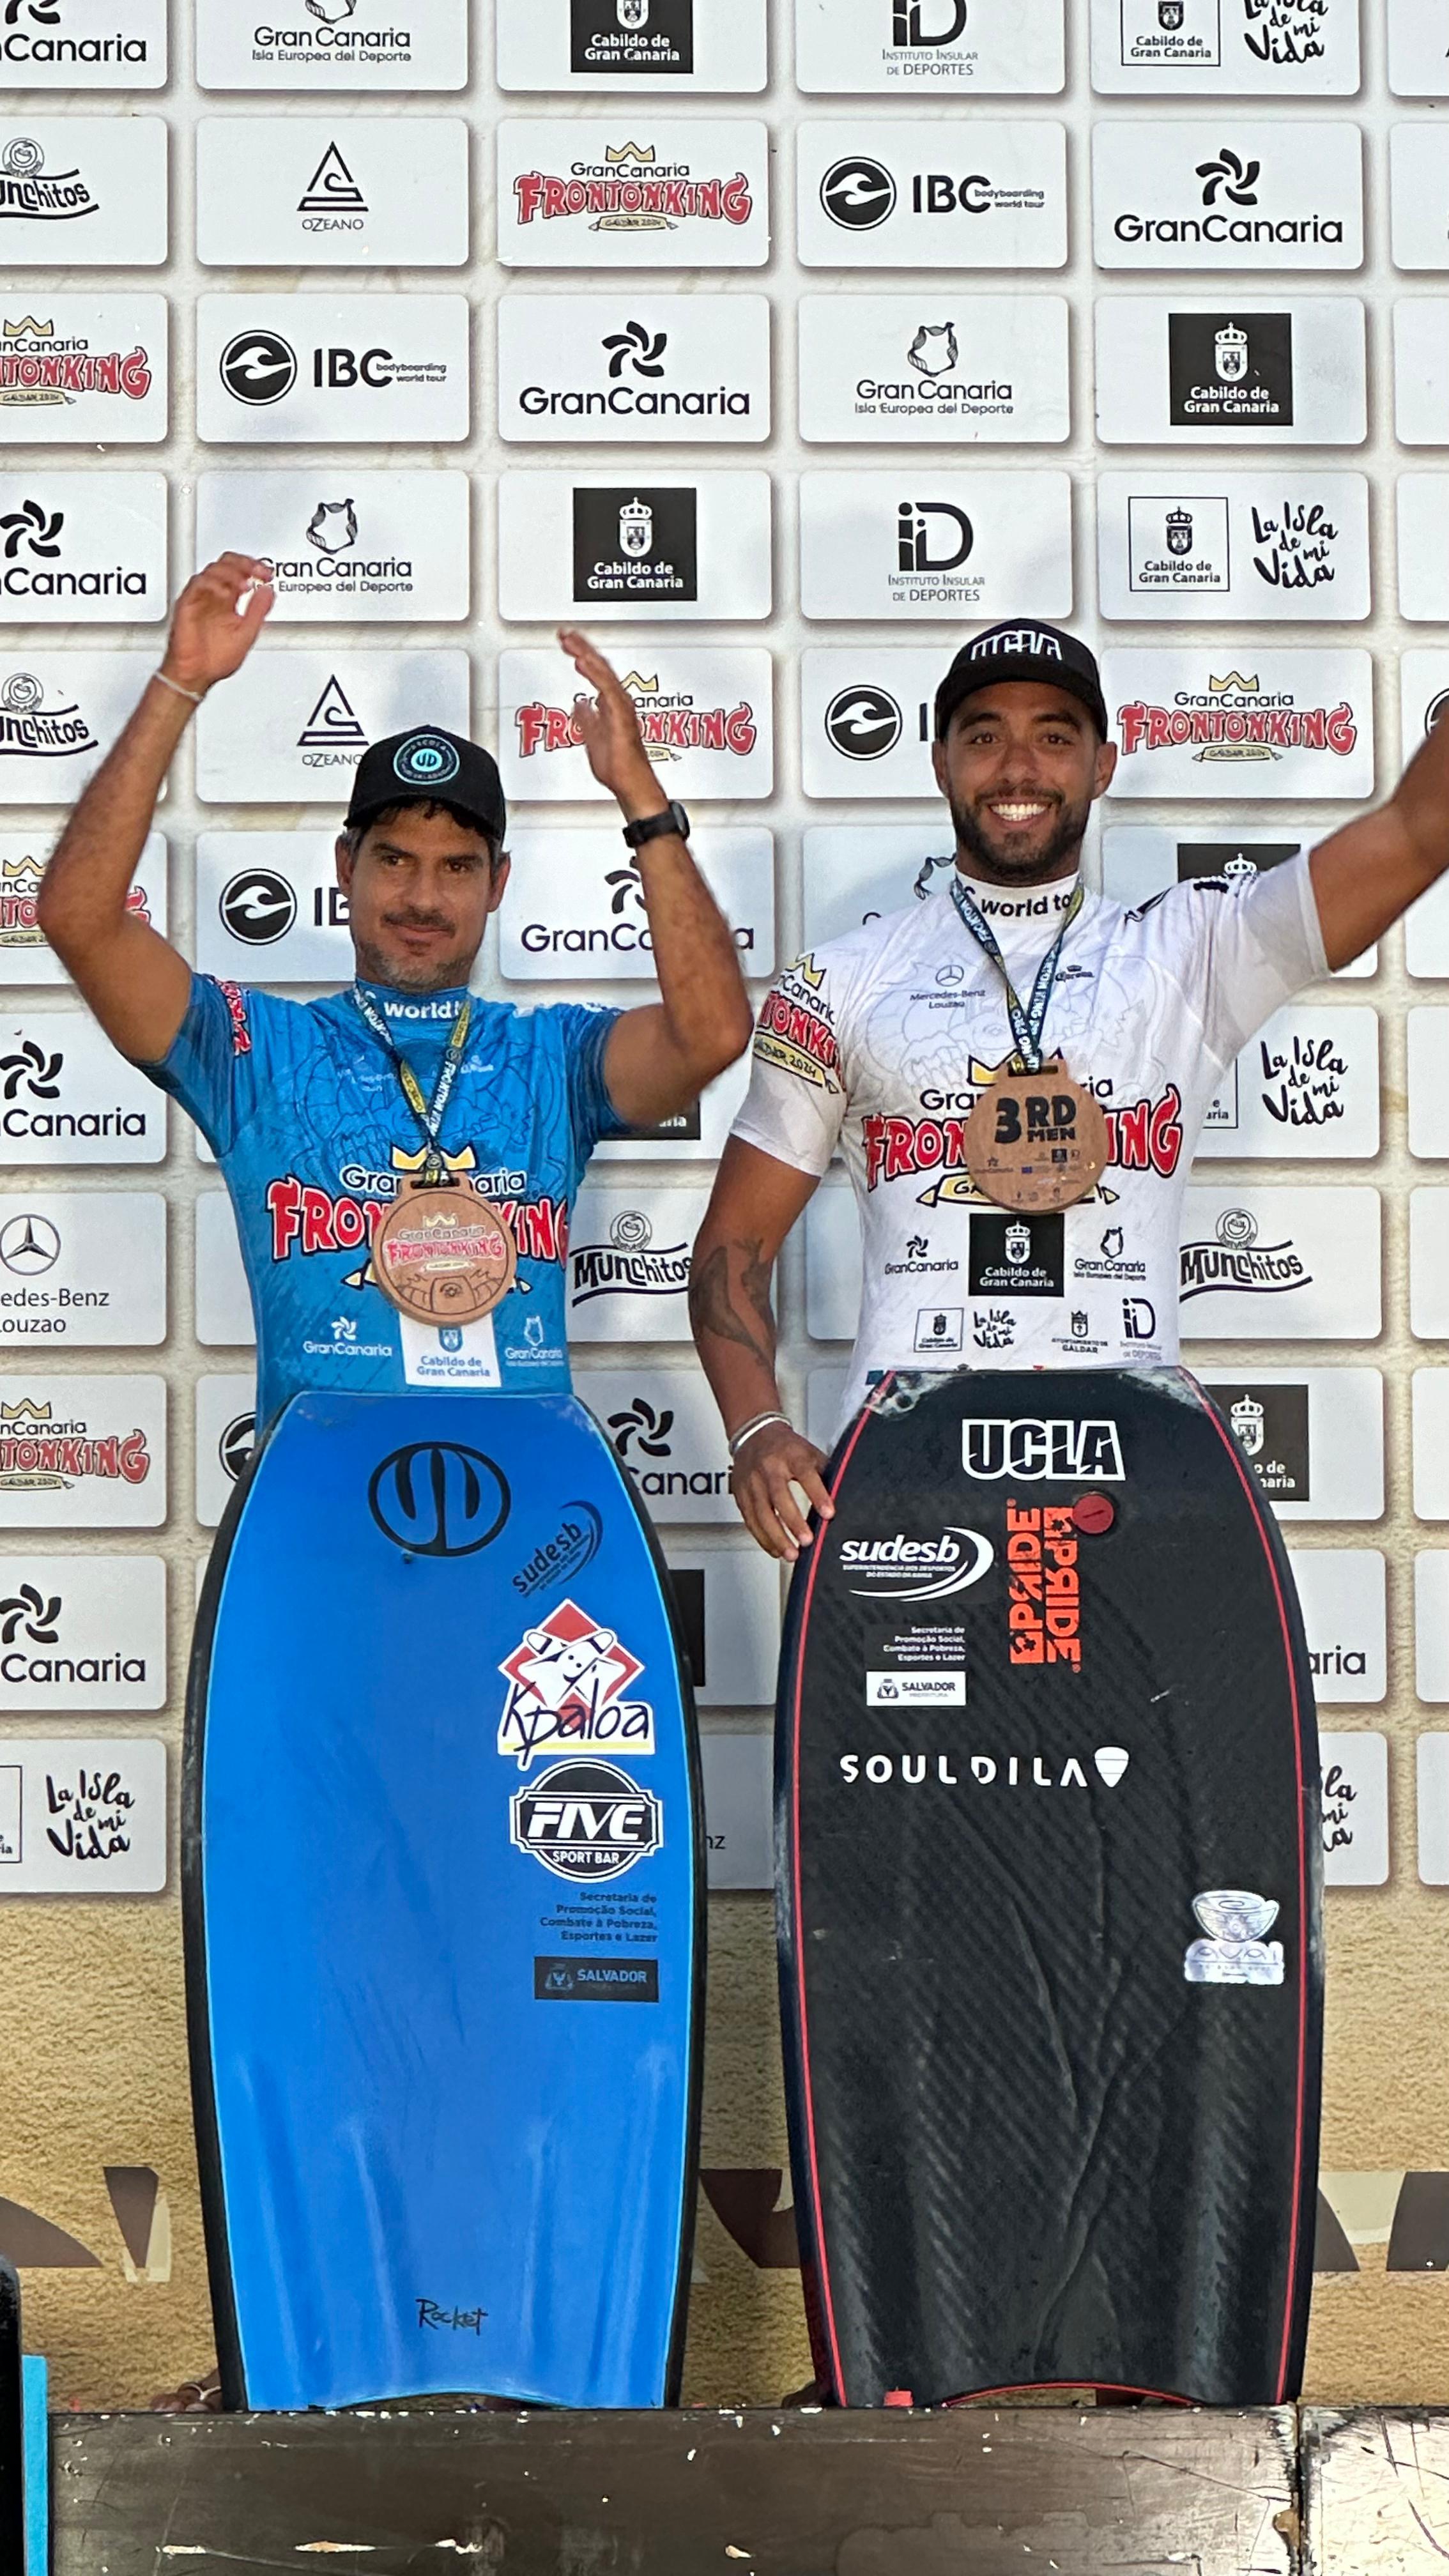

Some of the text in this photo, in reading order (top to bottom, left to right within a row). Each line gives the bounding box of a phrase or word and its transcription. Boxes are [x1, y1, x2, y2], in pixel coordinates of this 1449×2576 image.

[1269, 6, 1291, 27] de
[1293, 17, 1320, 37] mi
[254, 26, 410, 47] Gran Canaria
[591, 34, 670, 47] Cabildo de
[1136, 36, 1203, 46] Cabildo de
[1244, 24, 1324, 64] Vida
[252, 49, 411, 63] Isla Europea del Deporte
[585, 47, 680, 62] Gran Canaria
[1131, 47, 1211, 58] Gran Canaria
[903, 64, 973, 75] DEPORTES
[571, 162, 690, 178] GranCanaria
[513, 171, 751, 225] FRONTONKING
[913, 175, 992, 213] IBC
[302, 218, 364, 231] OZEANO
[1114, 214, 1342, 243] GranCanaria
[314, 349, 394, 388] IBC
[856, 379, 1012, 401] Gran Canaria
[1191, 386, 1269, 400] Cabildo de
[519, 386, 750, 415] GranCanaria
[1183, 400, 1279, 414] Gran Canaria
[854, 402, 1014, 415] Isla Europea del Deporte
[1252, 502, 1338, 543] La Isla
[1279, 530, 1330, 562] de mi
[317, 557, 412, 577] Canaria
[594, 563, 673, 574] Cabildo de
[1144, 560, 1211, 572] Cabildo de
[1253, 548, 1335, 588] Vida
[0, 567, 146, 595] Canaria
[587, 576, 684, 589] Gran Canaria
[1139, 572, 1220, 584] Gran Canaria
[279, 581, 332, 592] Europea
[335, 581, 355, 591] del
[360, 581, 413, 593] Deporte
[909, 589, 979, 602] DEPORTES
[1174, 691, 1294, 708] GranCanaria
[1117, 701, 1358, 756] FRONTONKING
[981, 896, 1048, 917] world
[910, 990, 986, 1000] Mercedes-Benz
[384, 1000, 452, 1019] world
[1261, 1036, 1348, 1080] La Isla
[1288, 1064, 1339, 1098] de mi
[1262, 1084, 1344, 1126] Vida
[0, 1107, 146, 1137] Canaria
[1027, 1128, 1076, 1143] MEN
[885, 1260, 958, 1275] GranCanaria
[985, 1267, 1046, 1277] Cabildo de
[1075, 1258, 1145, 1272] Gran Canaria
[1181, 1249, 1303, 1285] Munchitos
[980, 1277, 1054, 1288] Gran Canaria
[303, 1341, 392, 1357] GranCanaria
[421, 1356, 482, 1367] Cabildo de
[417, 1367, 490, 1377] Gran Canaria
[962, 1419, 1126, 1481] UCLA
[1266, 1460, 1285, 1473] de
[839, 1535, 960, 1562] sudesb
[512, 1522, 582, 1593] sudesb
[898, 1653, 934, 1662] Esportes
[902, 1682, 956, 1691] SALVADOR
[46, 1769, 135, 1814] La Isla
[73, 1799, 126, 1831] de mi
[527, 1802, 645, 1841] FIVE
[46, 1818, 130, 1860] Vida
[552, 1850, 619, 1864] SPORT BAR
[579, 1892, 657, 1903] Secretaria de
[556, 1905, 657, 1917] Promoção Social,
[540, 1917, 657, 1930] Combate Pobreza,
[561, 1931, 611, 1942] Esportes
[626, 1933, 658, 1942] Lazer
[577, 1968, 647, 1982] SALVADOR
[415, 2299, 488, 2336] Rocket
